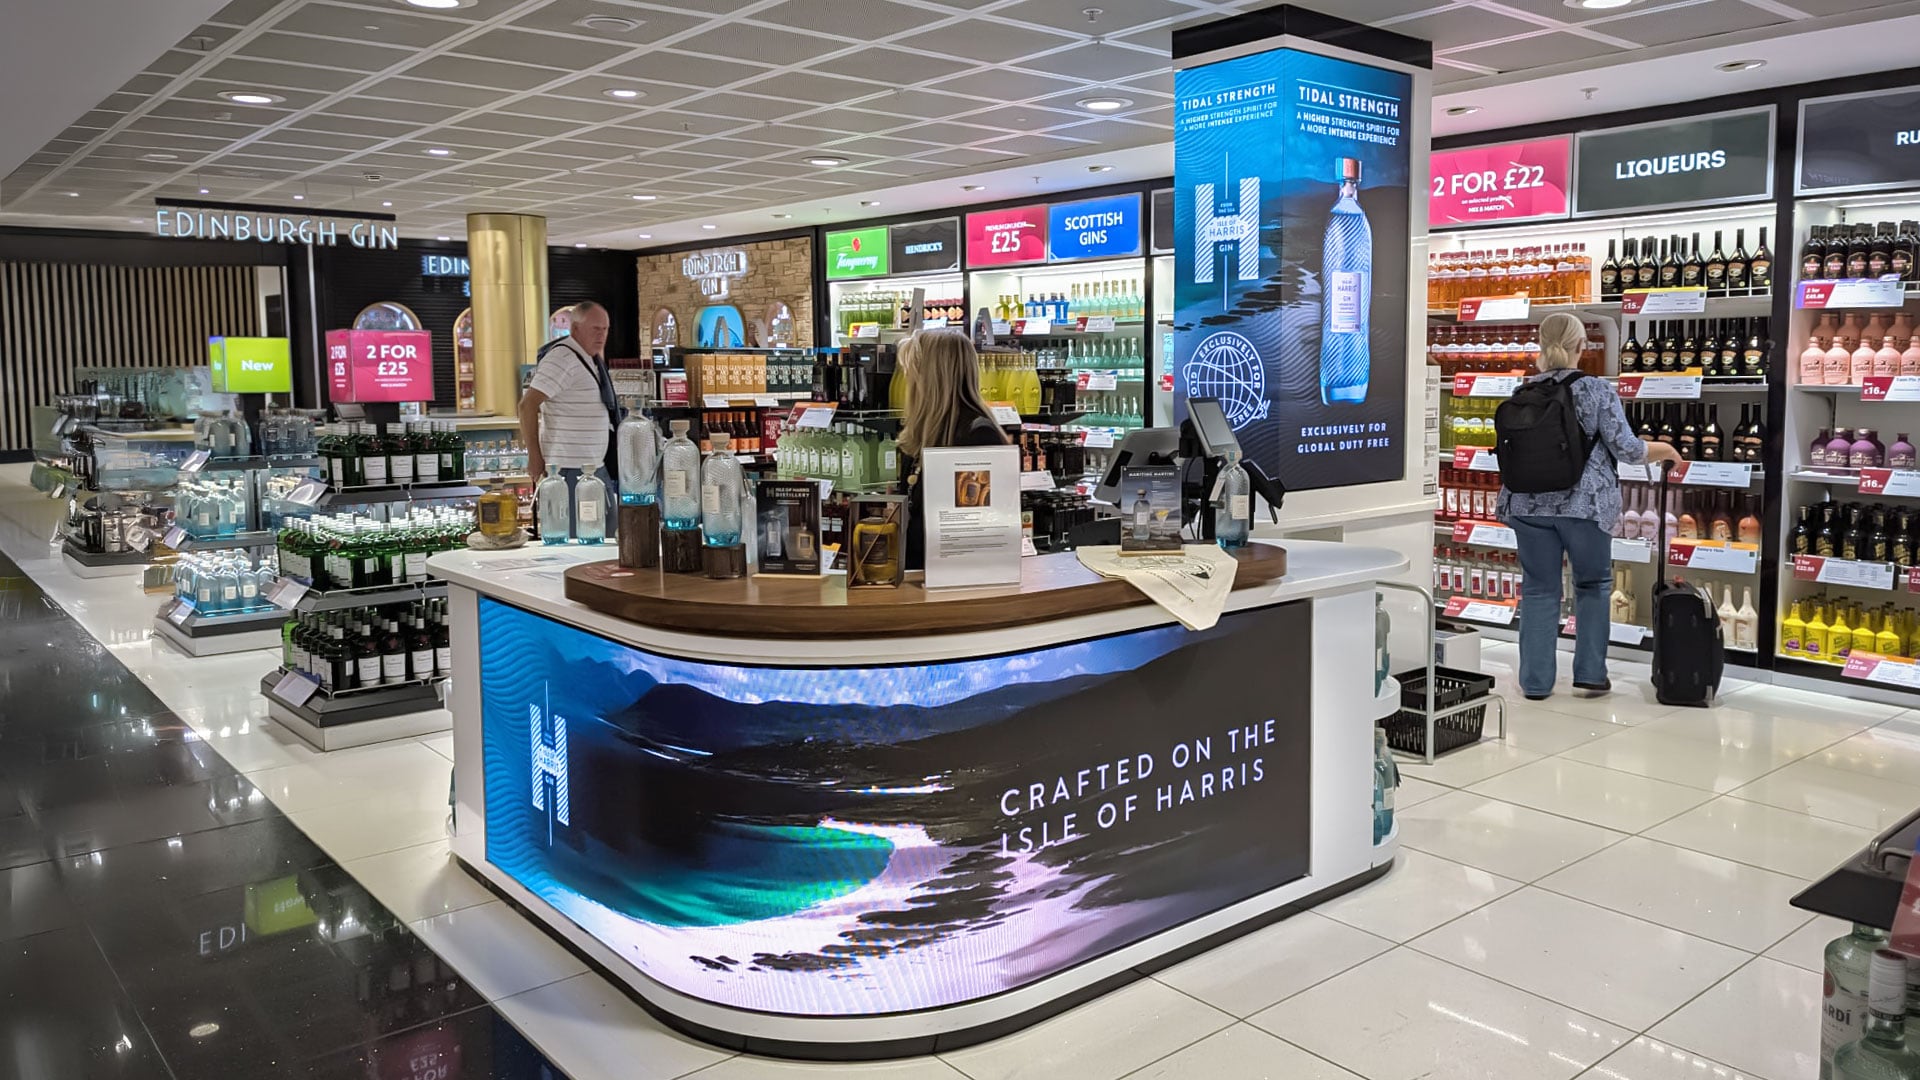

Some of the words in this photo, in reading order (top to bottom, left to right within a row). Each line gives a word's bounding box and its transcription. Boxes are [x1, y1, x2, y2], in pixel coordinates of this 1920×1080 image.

[1182, 98, 1214, 111] TIDAL
[1217, 83, 1276, 103] STRENGTH
[1299, 86, 1334, 106] TIDAL
[1338, 95, 1399, 118] STRENGTH
[1186, 114, 1209, 124] HIGHER
[1210, 108, 1242, 120] STRENGTH
[1243, 105, 1263, 115] SPIRIT
[1264, 101, 1278, 110] FOR
[1189, 122, 1207, 131] MORE
[1208, 117, 1234, 128] INTENSE
[1235, 110, 1274, 124] EXPERIENCE
[1303, 112, 1330, 124] HIGHER
[1331, 118, 1365, 130] STRENGTH
[1366, 122, 1386, 133] SPIRIT
[1387, 127, 1400, 136] FOR
[1307, 124, 1327, 135] MORE
[1328, 128, 1357, 140] INTENSE
[1358, 132, 1396, 146] EXPERIENCE
[1615, 150, 1726, 180] LIQUEURS
[1433, 176, 1445, 197] 2
[1451, 171, 1497, 195] FOR
[1503, 165, 1545, 190] £22
[1484, 204, 1504, 212] MATCH
[156, 210, 338, 246] EDINBURGH
[350, 223, 398, 249] GIN
[1064, 211, 1123, 231] SCOTTISH
[1209, 225, 1245, 237] HARRIS
[992, 231, 1020, 253] £25
[1079, 230, 1107, 246] GINS
[1219, 243, 1233, 252] GIN
[701, 278, 718, 297] GIN
[331, 346, 336, 359] 2
[335, 345, 347, 359] FOR
[366, 345, 377, 359] 2
[380, 345, 417, 359] FOR
[1198, 336, 1256, 361] EXCLUSIVELY
[241, 360, 274, 372] New
[335, 362, 346, 376] £25
[378, 362, 408, 376] £25
[1252, 364, 1261, 389] FOR
[1232, 403, 1254, 426] FREE
[1301, 424, 1366, 437] EXCLUSIVELY
[1368, 422, 1387, 433] FOR
[1297, 442, 1336, 454] GLOBAL
[1339, 440, 1364, 450] DUTY
[1367, 437, 1390, 448] FREE
[1000, 753, 1154, 817] CRAFTED
[1172, 737, 1211, 769] ON
[1227, 719, 1276, 754] THE
[1002, 812, 1077, 858] ISLE
[1098, 794, 1138, 829] OF
[1157, 758, 1265, 812] HARRIS
